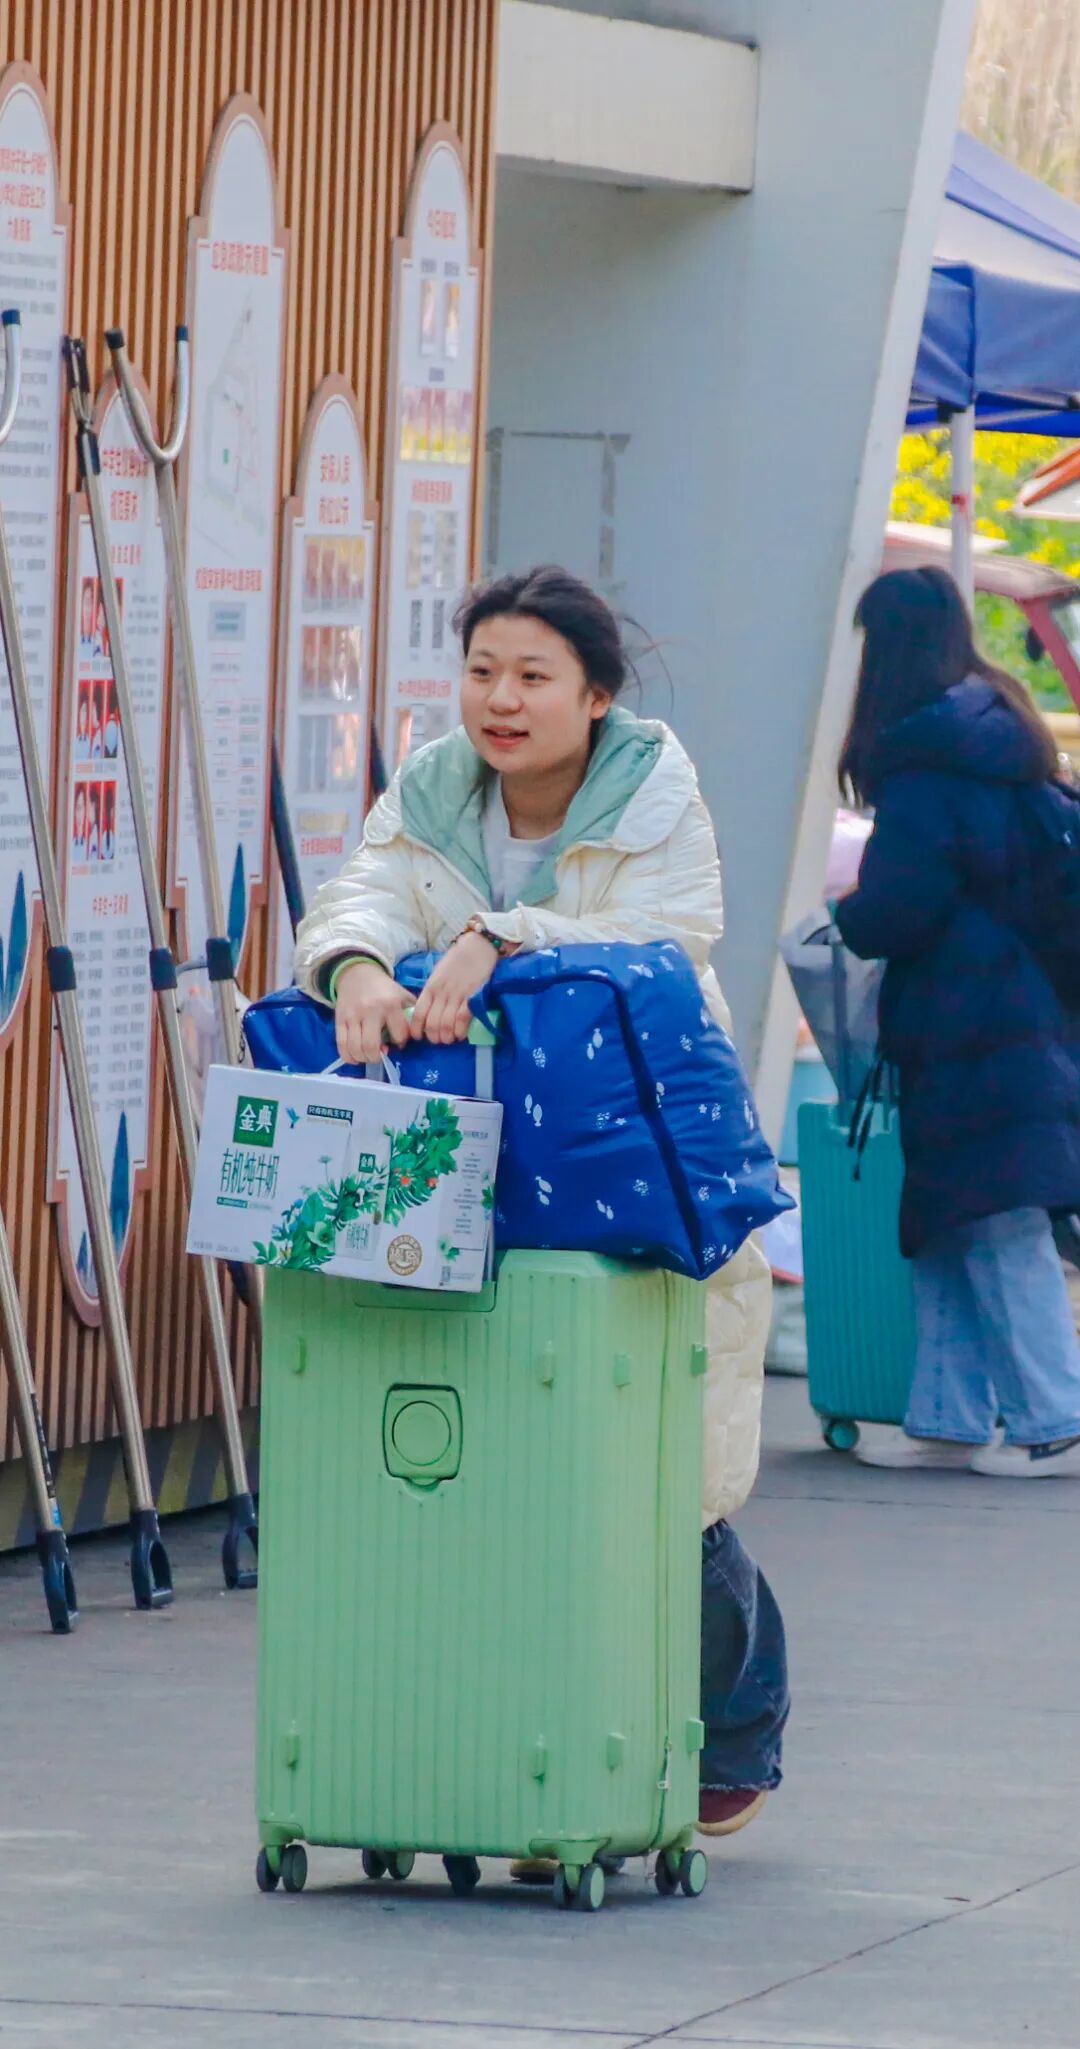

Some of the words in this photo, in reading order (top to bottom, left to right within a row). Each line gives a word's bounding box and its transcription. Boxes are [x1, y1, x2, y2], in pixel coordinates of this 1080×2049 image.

[212, 241, 268, 275] 应急疏散示意图
[239, 1103, 272, 1133] 金典
[221, 1148, 280, 1198] 有机纯牛奶
